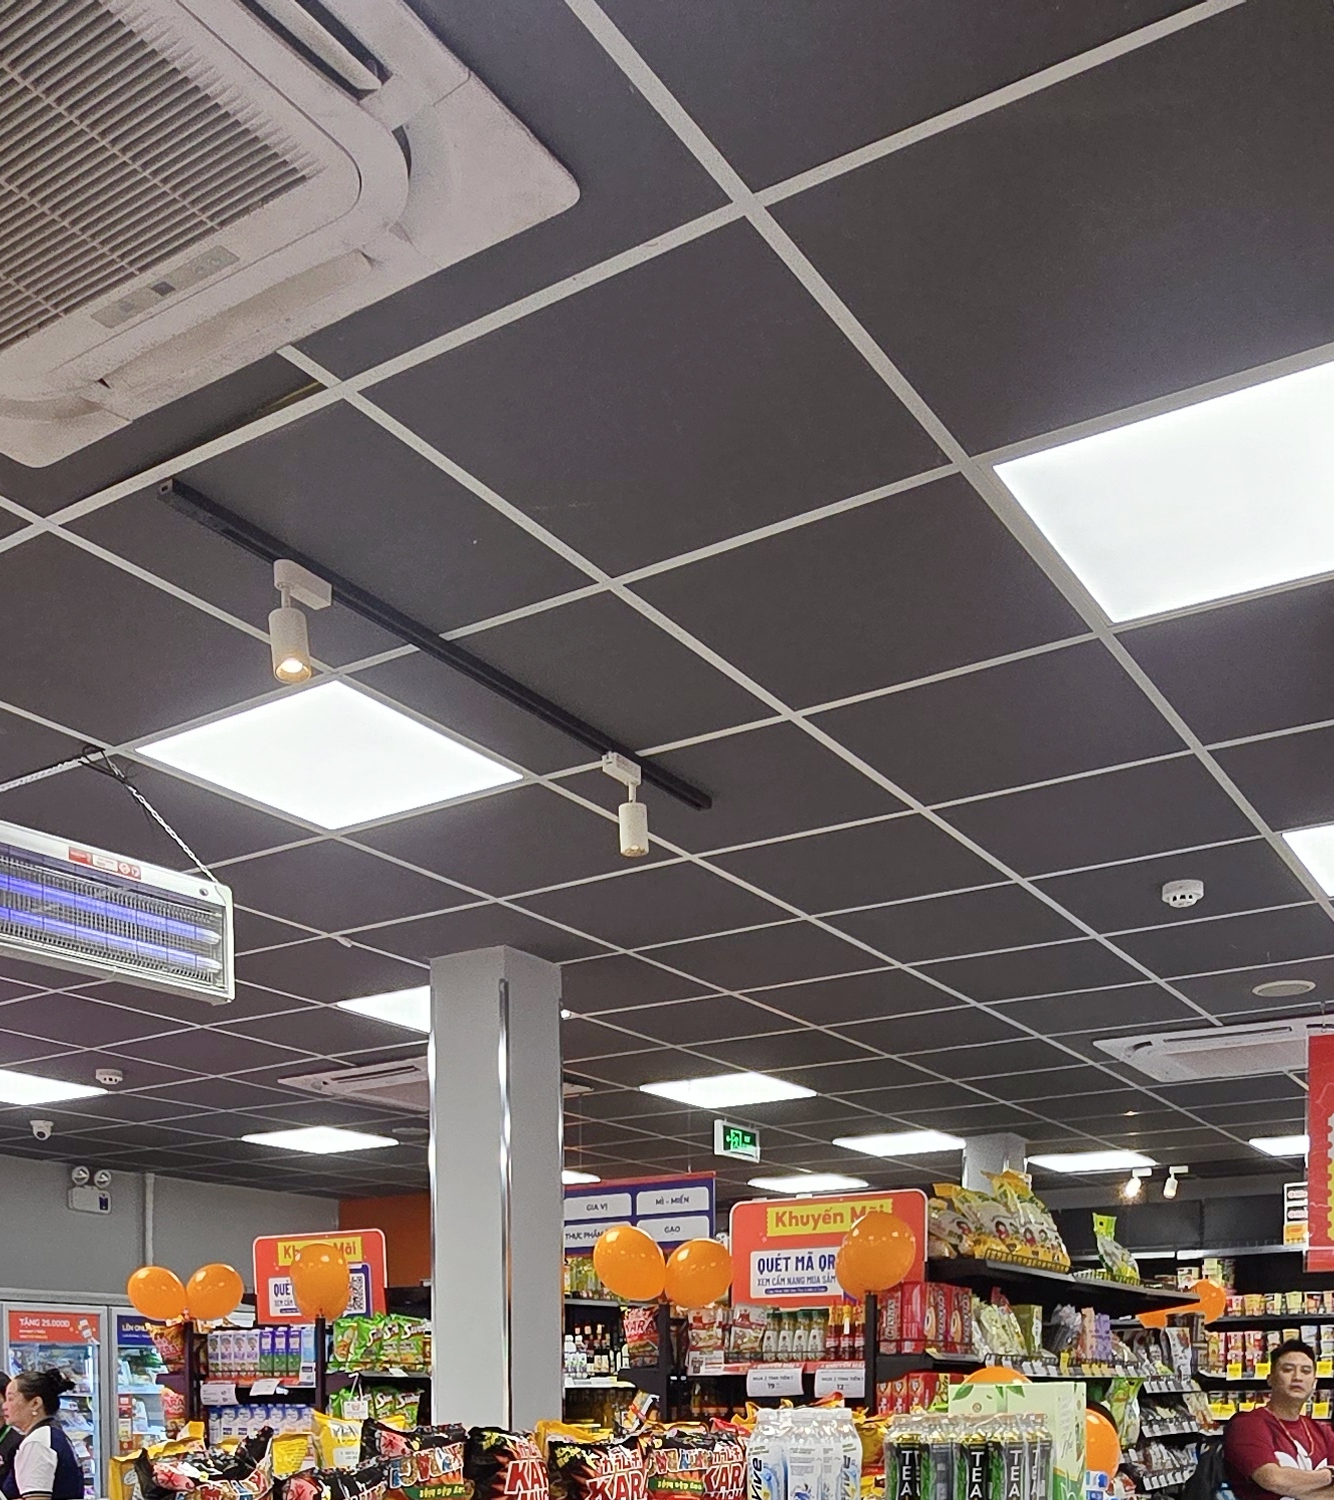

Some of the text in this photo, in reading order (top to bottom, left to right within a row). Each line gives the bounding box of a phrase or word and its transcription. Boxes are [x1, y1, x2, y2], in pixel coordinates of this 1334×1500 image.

[775, 1206, 845, 1231] Khuyến
[757, 1252, 835, 1275] QUÉT MÃ QR
